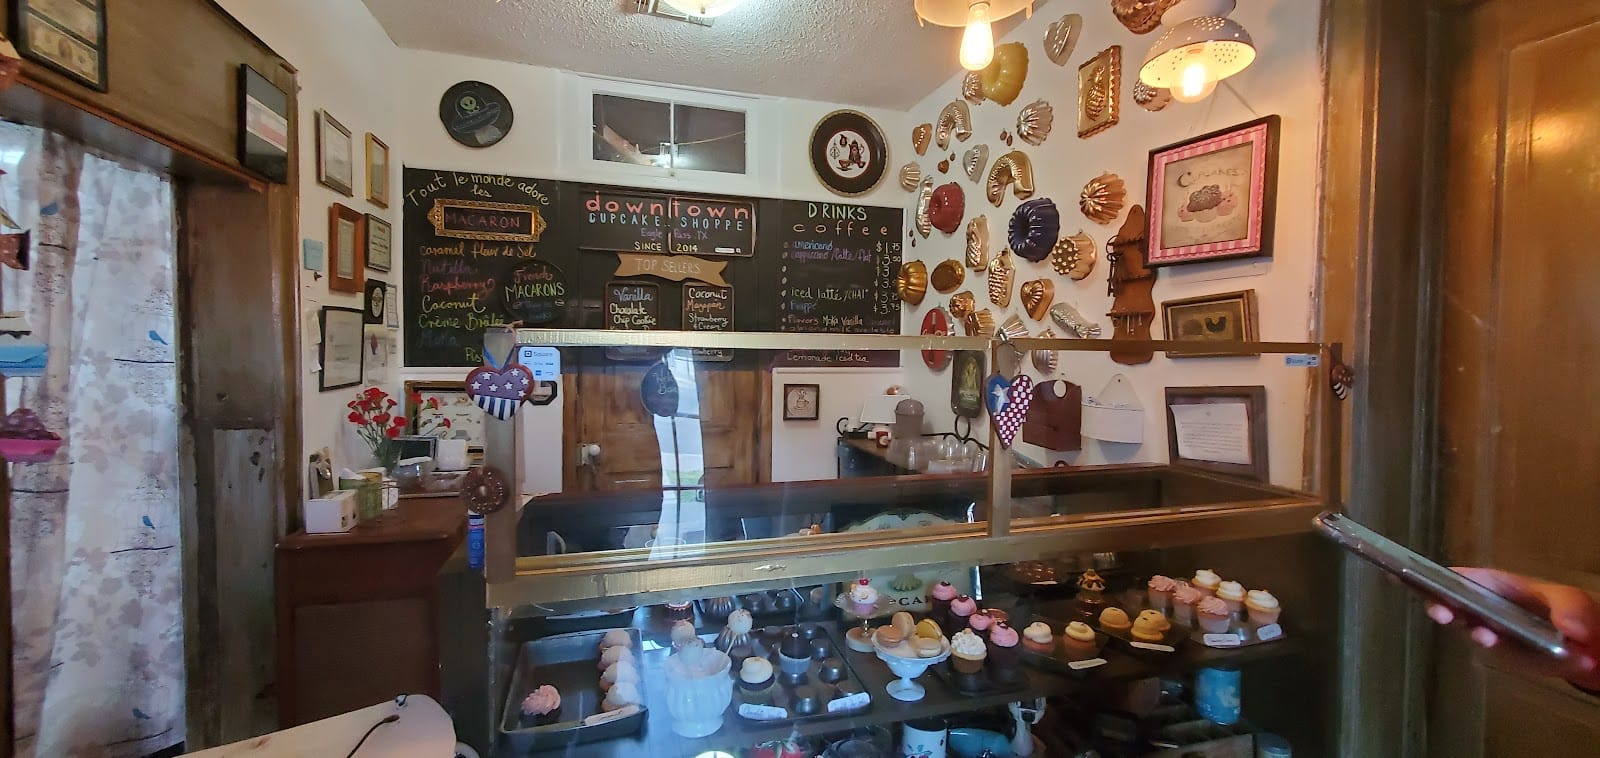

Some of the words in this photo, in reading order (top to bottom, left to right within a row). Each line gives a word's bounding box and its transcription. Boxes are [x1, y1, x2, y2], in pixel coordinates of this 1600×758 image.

[406, 172, 446, 206] Tout
[453, 172, 468, 186] le
[470, 174, 515, 187] monde
[517, 182, 550, 206] adore
[471, 184, 492, 198] les
[808, 202, 867, 221] DRINKS
[445, 212, 520, 229] MACARON
[588, 212, 660, 226] CUPCAKE
[680, 217, 743, 231] SHOPPE
[793, 220, 888, 237] coffee
[641, 227, 662, 240] Eagle
[634, 241, 662, 251] SINCE
[676, 243, 698, 252] 2014
[635, 258, 657, 271] TOP
[661, 260, 701, 274] SELLERS
[505, 281, 565, 303] MACARONS
[613, 287, 653, 302] Vanilla
[688, 287, 728, 299] Coconut
[422, 292, 487, 313] Coconut
[613, 315, 630, 328] Chip
[631, 315, 657, 326] Cookie
[465, 346, 484, 363] Pis
[786, 352, 832, 362] Lemonade
